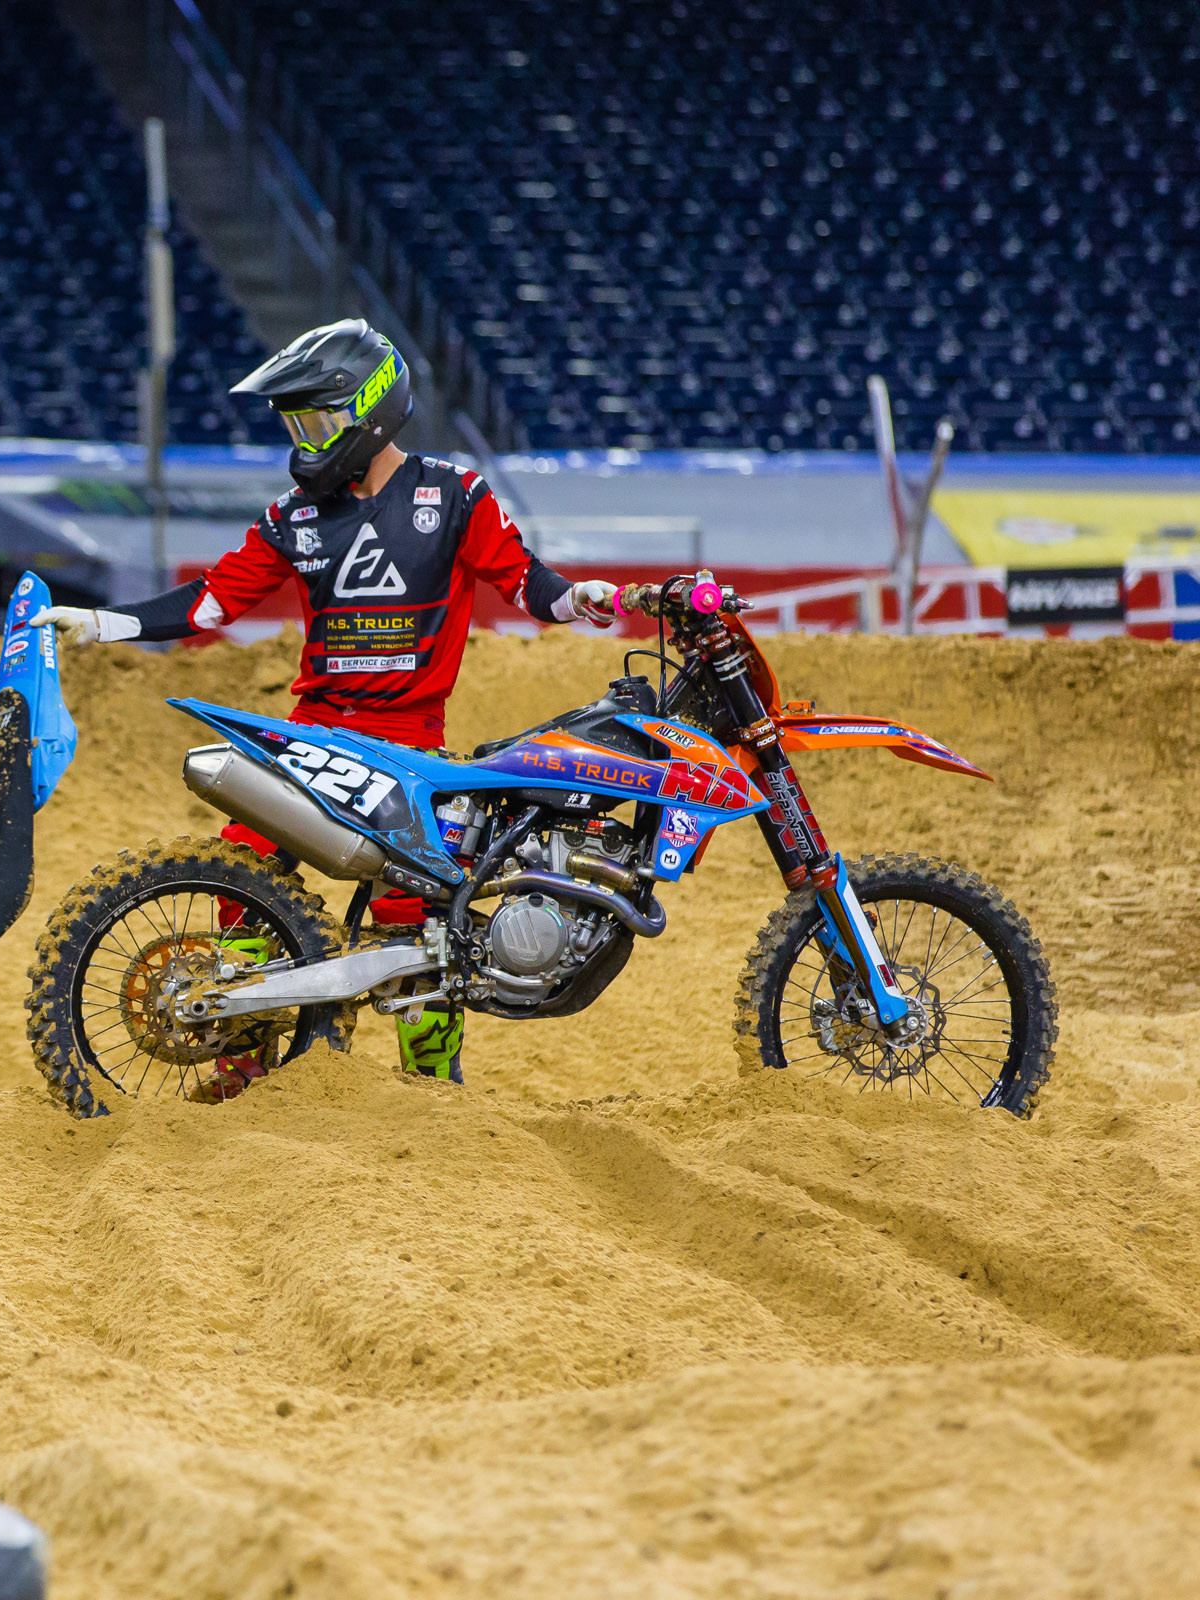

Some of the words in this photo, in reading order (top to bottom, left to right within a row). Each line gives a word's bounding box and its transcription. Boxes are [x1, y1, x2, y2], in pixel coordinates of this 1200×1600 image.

[355, 354, 397, 417] LEATT
[293, 557, 331, 573] Bihr
[40, 605, 55, 669] DUNL
[327, 619, 350, 630] H.S.
[353, 617, 415, 630] TRUCK
[341, 659, 378, 667] SERVICE
[380, 657, 414, 666] CENTER
[276, 741, 399, 818] 221
[523, 752, 566, 773] H.S.
[572, 760, 653, 789] TRUCK
